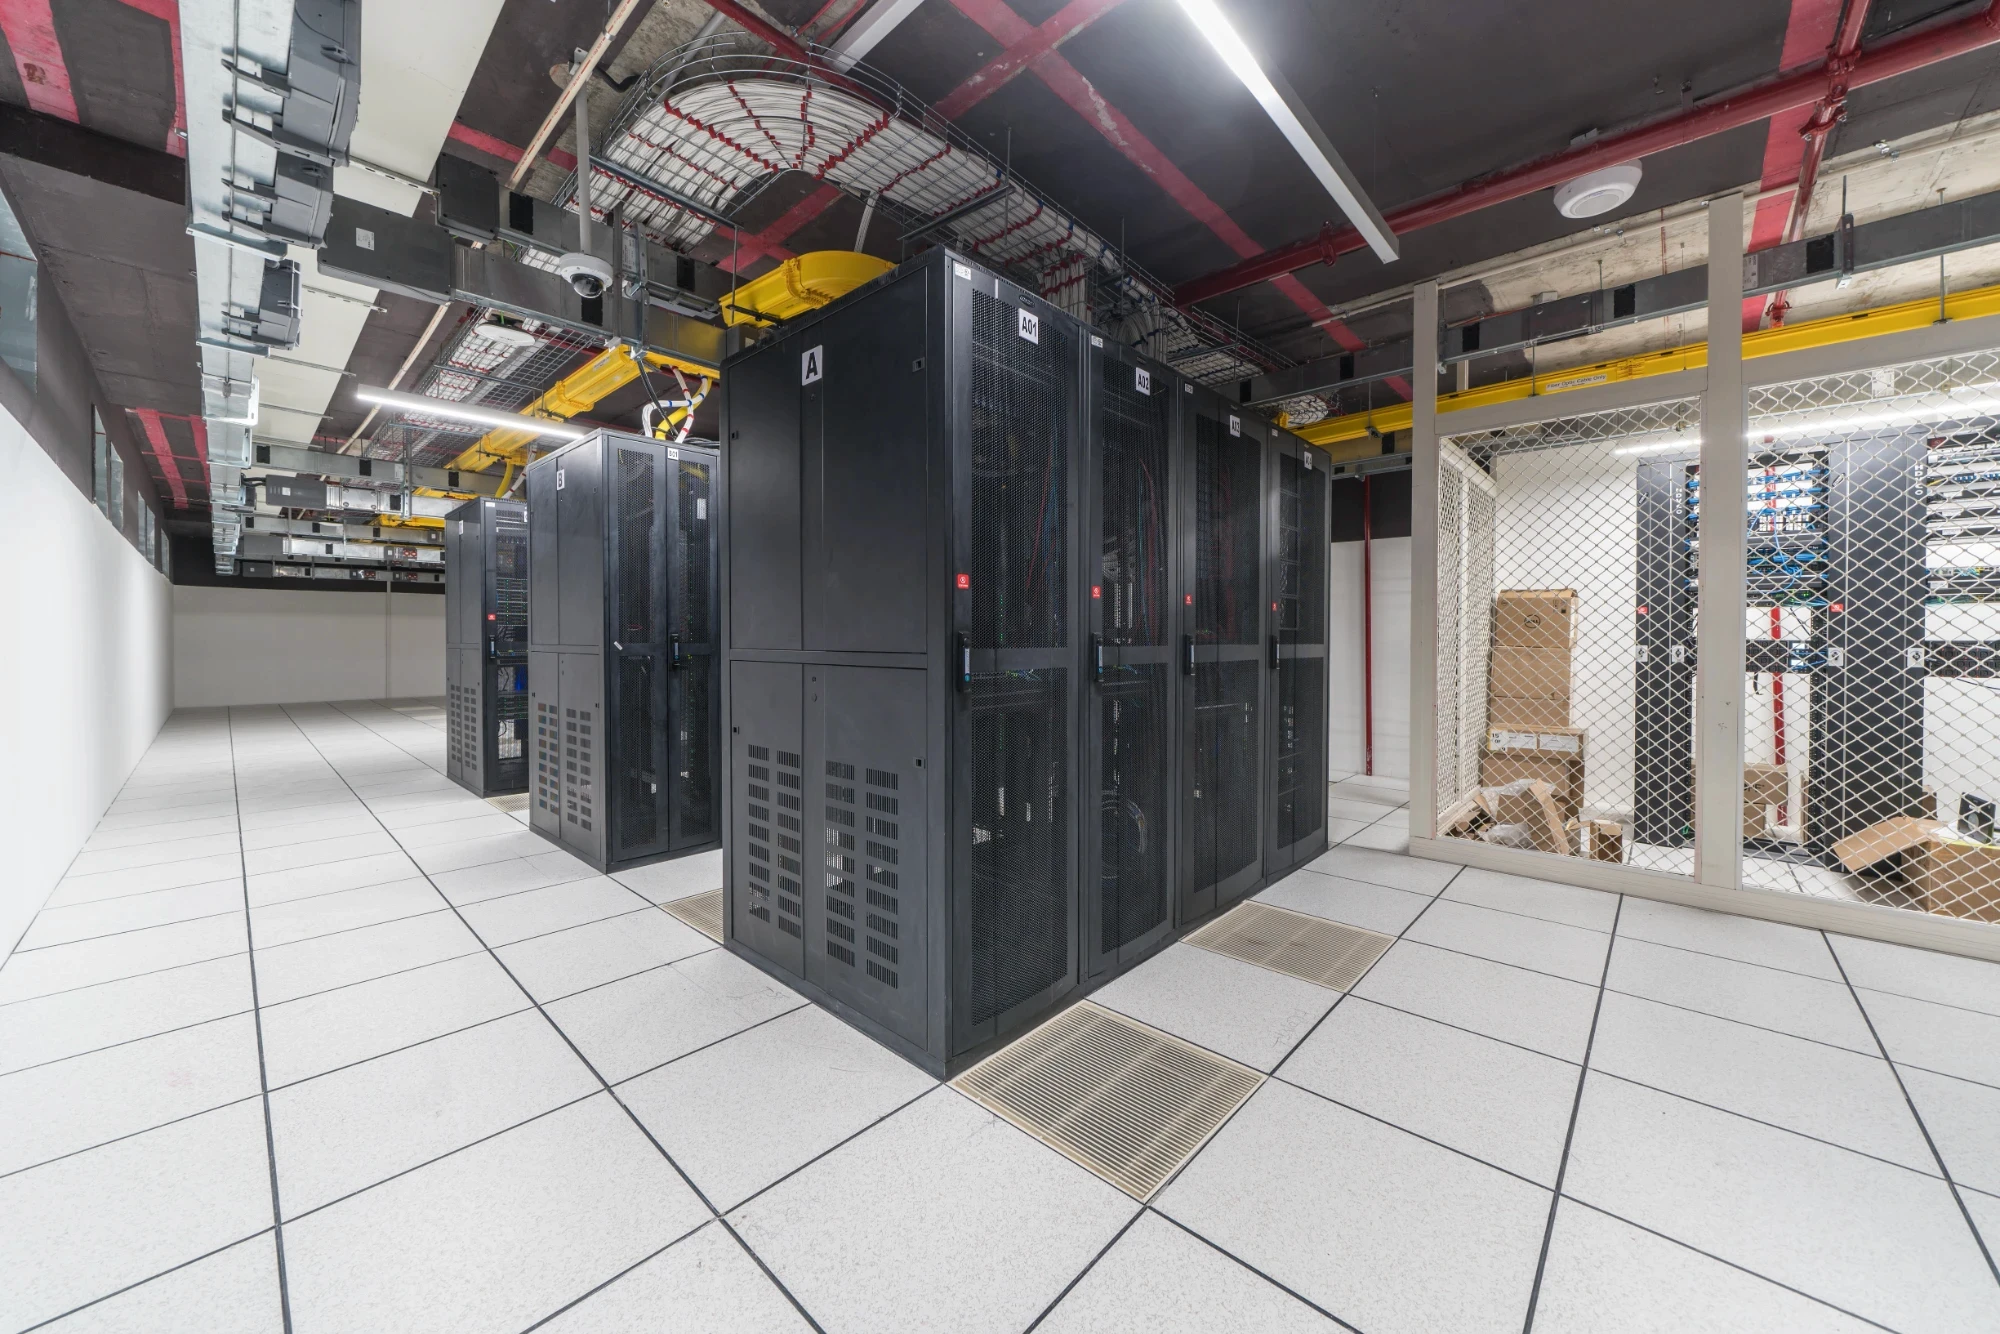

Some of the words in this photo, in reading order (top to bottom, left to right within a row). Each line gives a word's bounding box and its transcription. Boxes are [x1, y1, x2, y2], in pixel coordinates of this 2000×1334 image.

[1021, 316, 1037, 338] A01
[805, 351, 819, 380] A
[1137, 373, 1149, 391] A02
[558, 472, 563, 488] B
